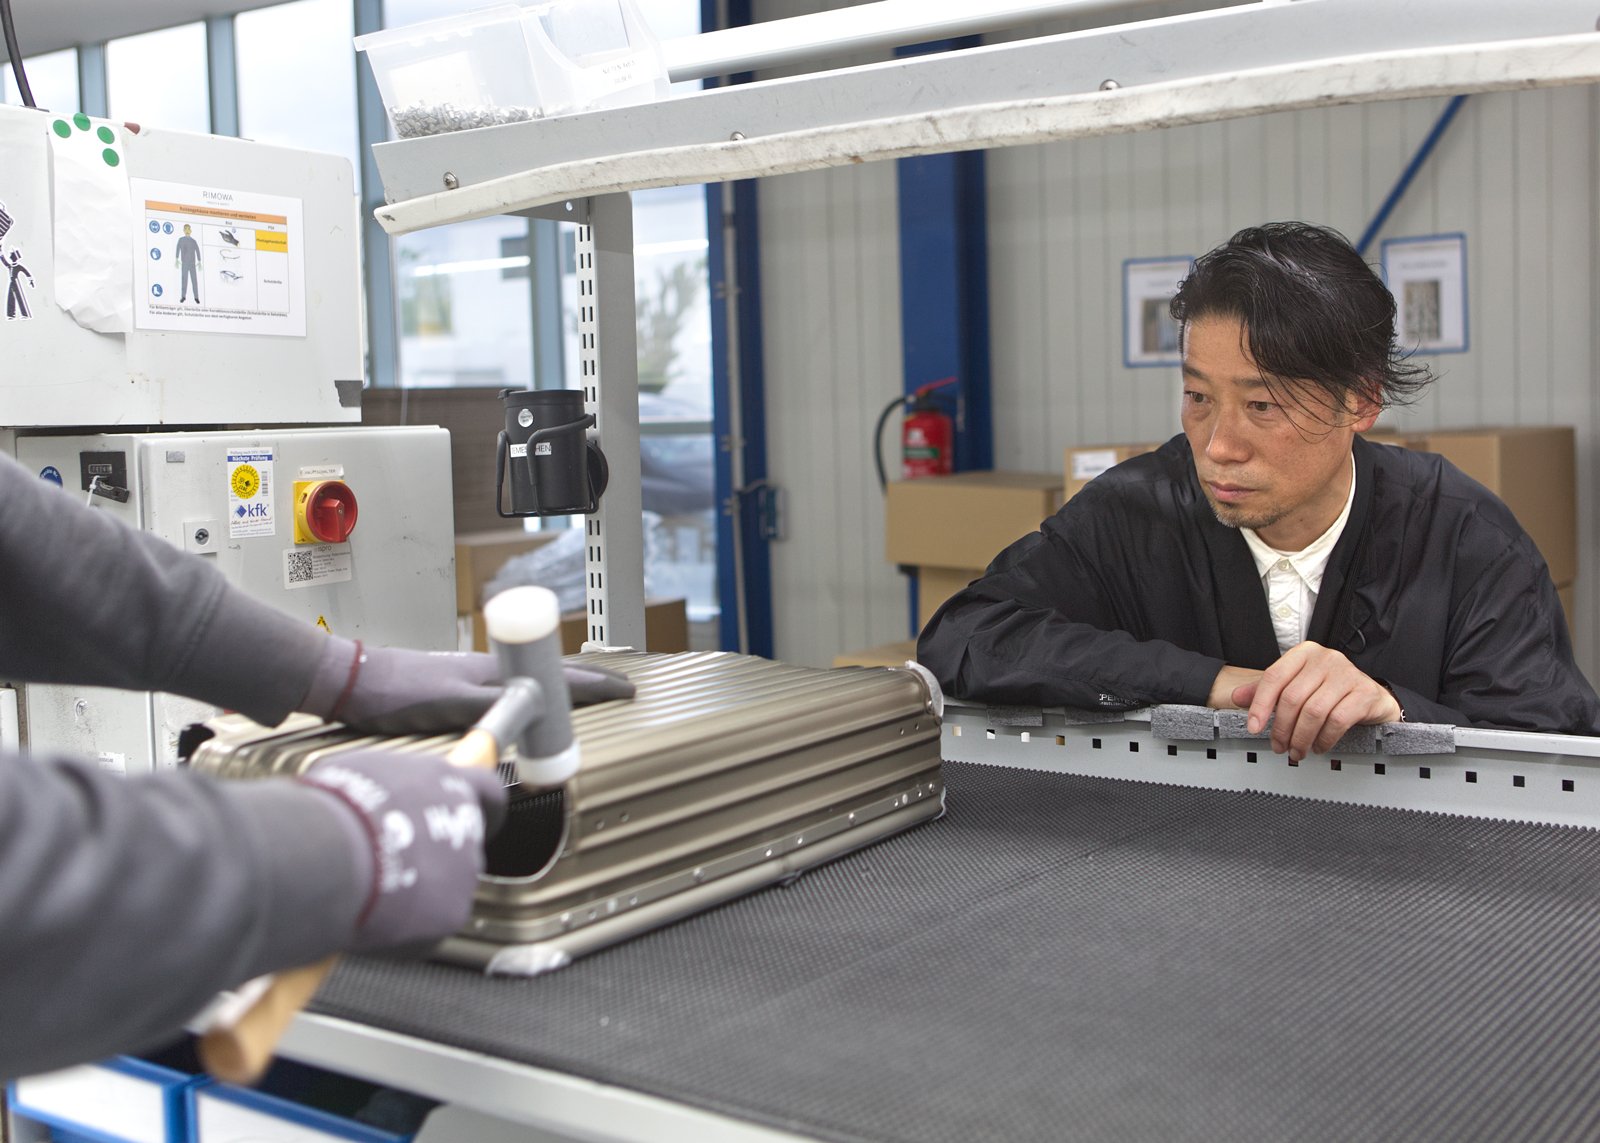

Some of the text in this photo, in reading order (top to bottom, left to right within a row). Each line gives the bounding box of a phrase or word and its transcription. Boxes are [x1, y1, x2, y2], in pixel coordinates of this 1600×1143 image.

[202, 190, 234, 202] RIMOWA
[251, 454, 269, 462] Prüfung
[247, 503, 267, 518] kfk
